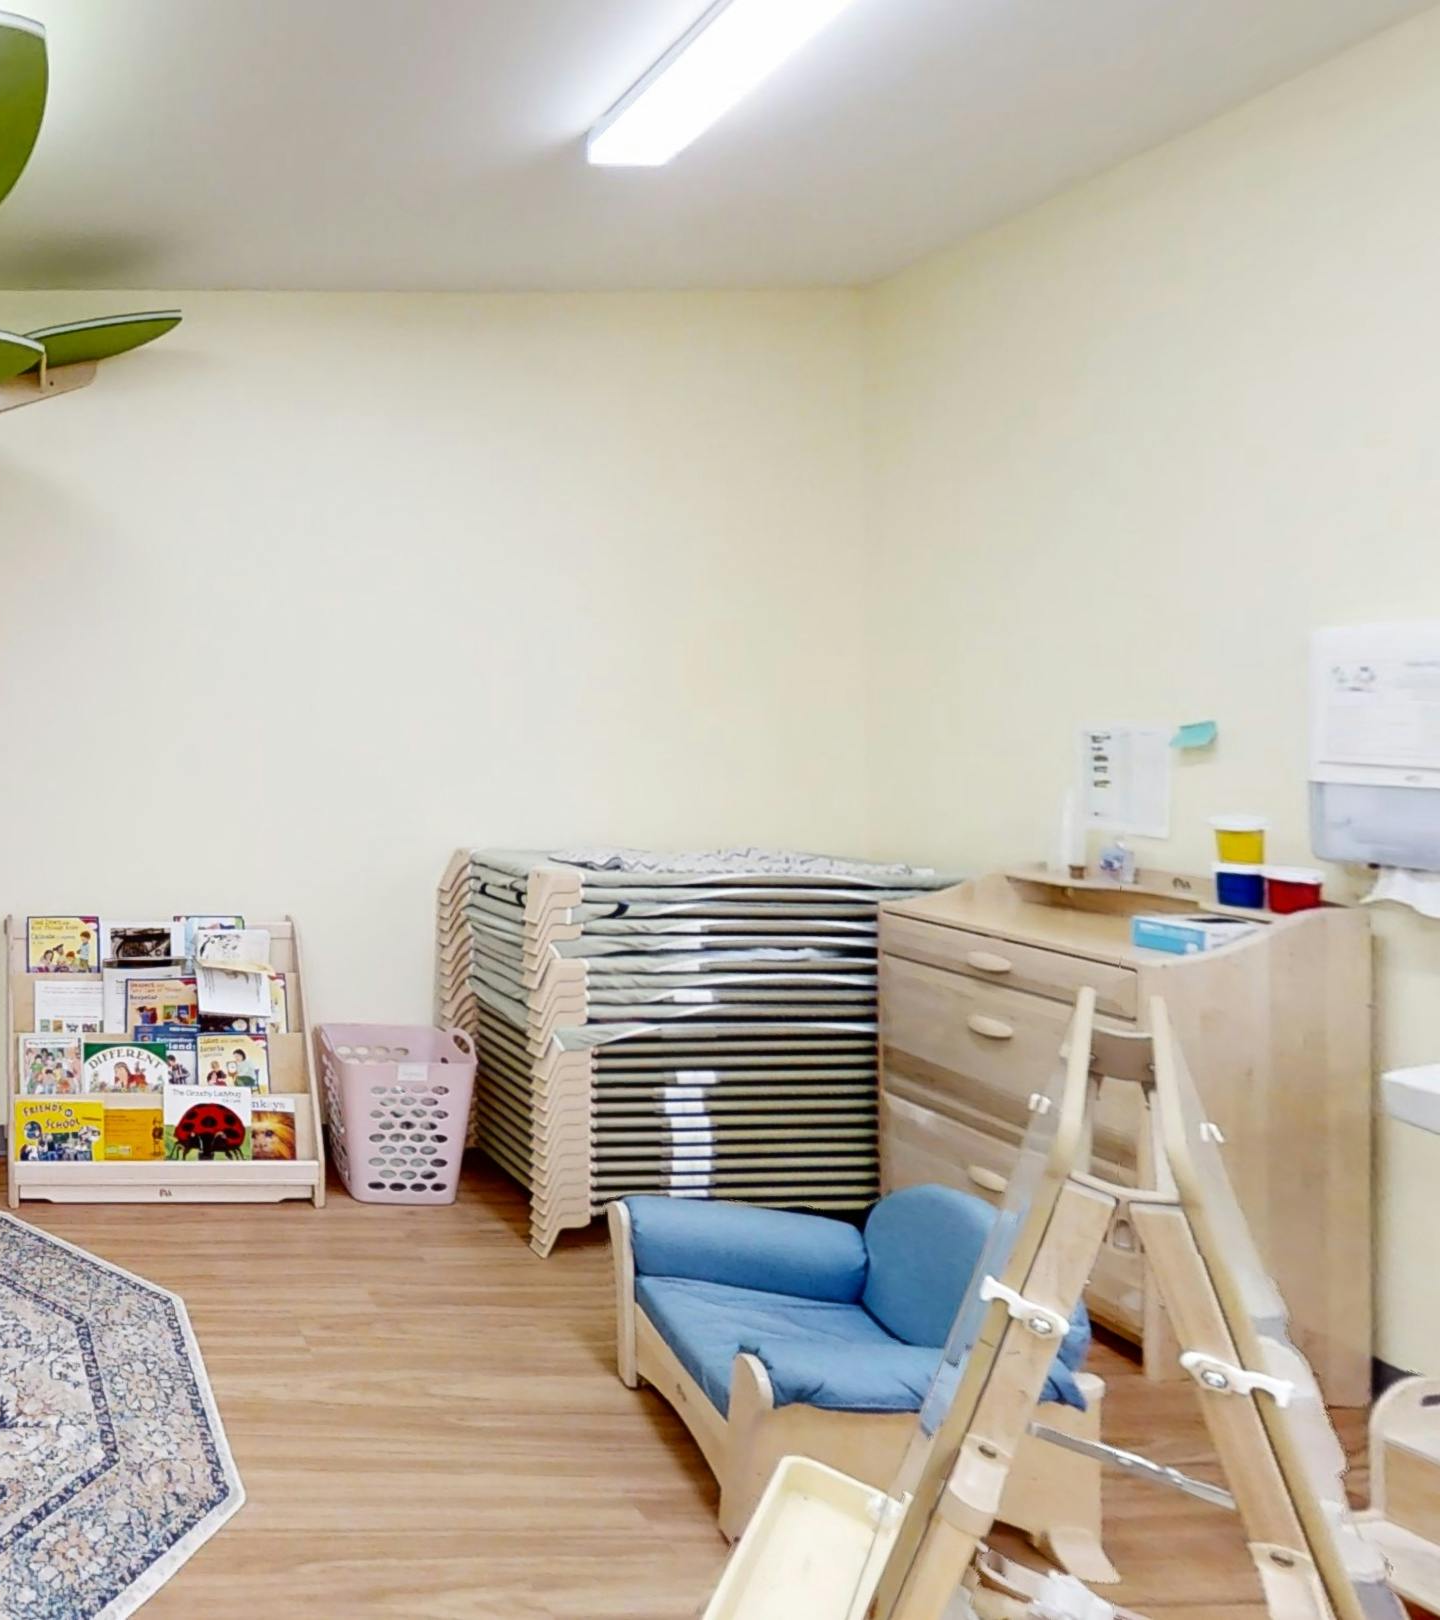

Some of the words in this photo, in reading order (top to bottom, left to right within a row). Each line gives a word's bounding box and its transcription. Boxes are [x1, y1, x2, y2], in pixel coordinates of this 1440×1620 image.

[88, 1048, 161, 1069] DIFFERENT
[23, 1104, 62, 1116] FRIENDS
[46, 1118, 80, 1128] SCHOOL
